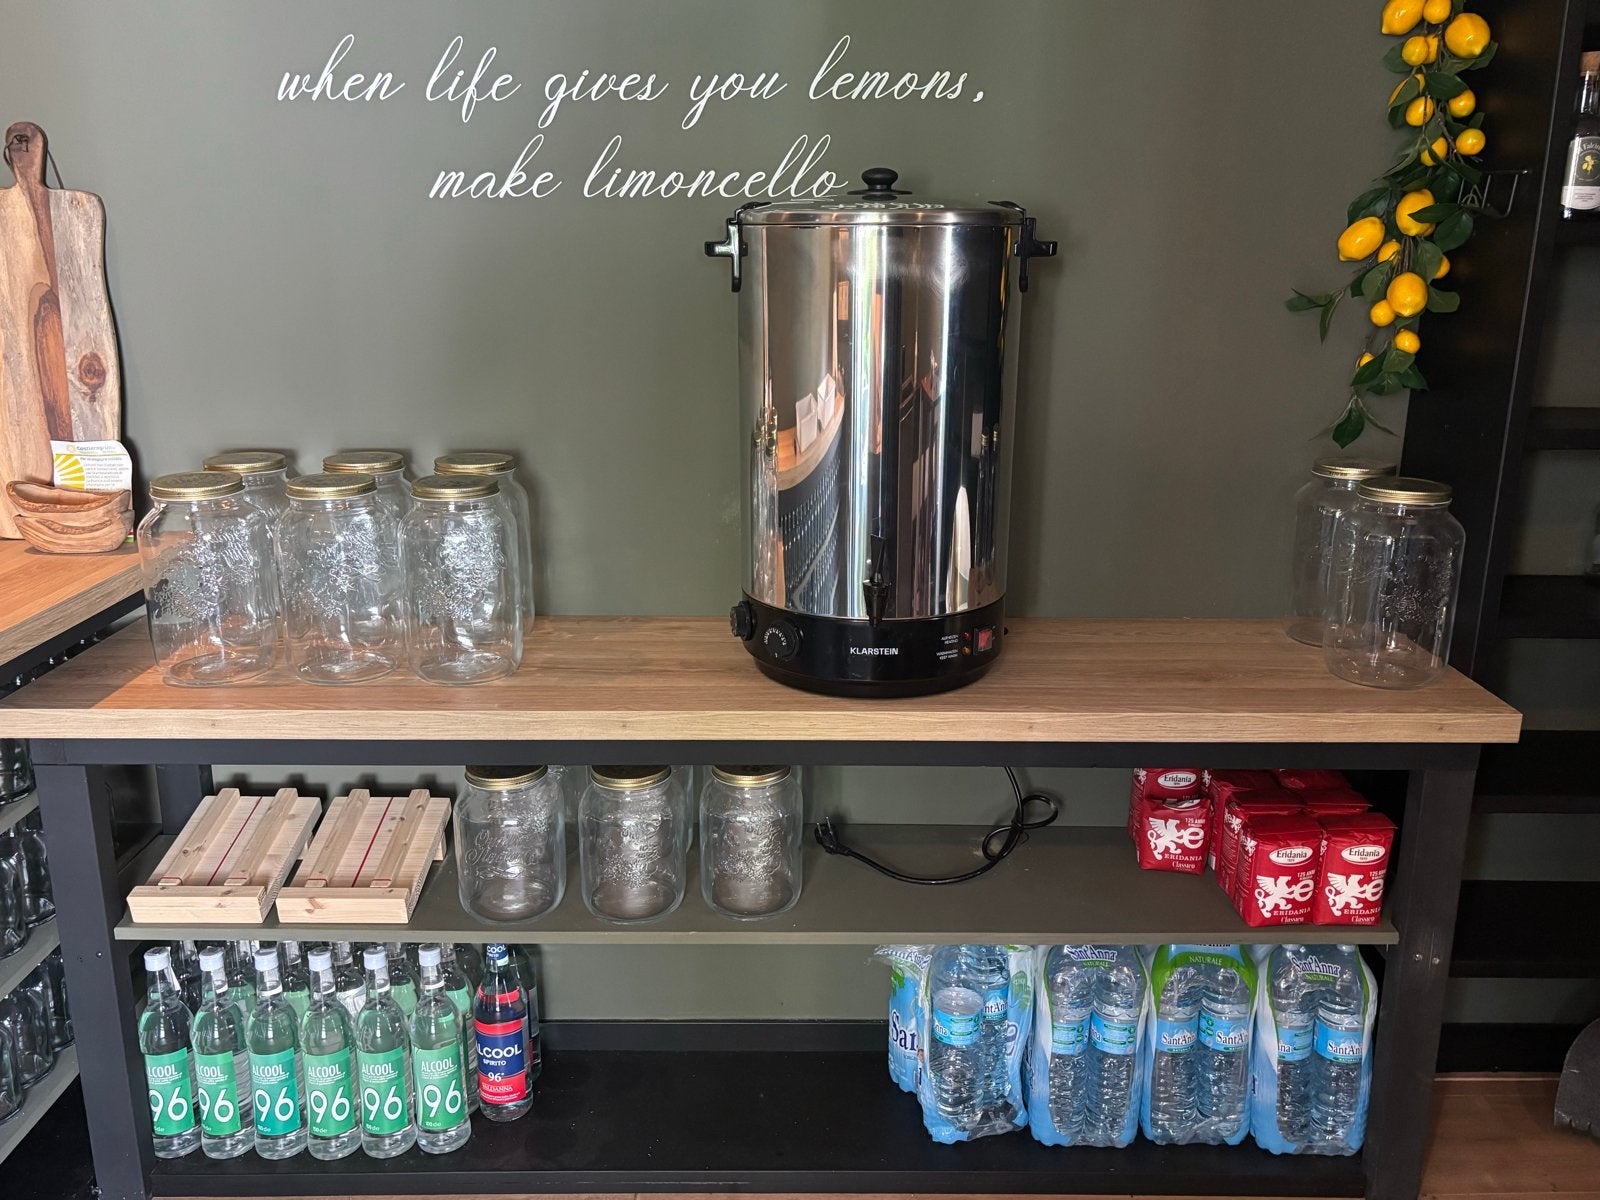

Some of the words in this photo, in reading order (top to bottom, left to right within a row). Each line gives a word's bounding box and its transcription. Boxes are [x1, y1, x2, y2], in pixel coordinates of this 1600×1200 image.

[277, 33, 405, 101] when
[425, 35, 521, 123] life
[538, 69, 669, 129] gives
[681, 72, 788, 130] you
[808, 34, 984, 103] lemons,
[428, 133, 562, 198] make
[583, 134, 849, 199] limoncello
[849, 646, 899, 656] KLARSTEIN
[1164, 775, 1192, 783] Eridania
[1164, 853, 1202, 861] ERIDANIA
[1276, 850, 1307, 859] Eridania
[1348, 848, 1380, 857] Eridania
[1273, 907, 1311, 916] ERIDANIA
[1064, 945, 1118, 961] Sant'Anna
[1189, 956, 1222, 966] NATURALE
[1290, 955, 1341, 977] Sant'Anna
[362, 1062, 394, 1076] ALCOOL
[421, 1057, 454, 1072] ALCOOL
[483, 1059, 507, 1067] SPIRITO
[252, 1064, 285, 1077] ALCOOL
[308, 1064, 341, 1078] ALCOOL
[149, 1087, 188, 1121] 96
[198, 1088, 234, 1123] 96
[255, 1087, 294, 1122] 96
[310, 1087, 350, 1123] 96
[364, 1086, 403, 1121] 96
[423, 1079, 461, 1118] 96
